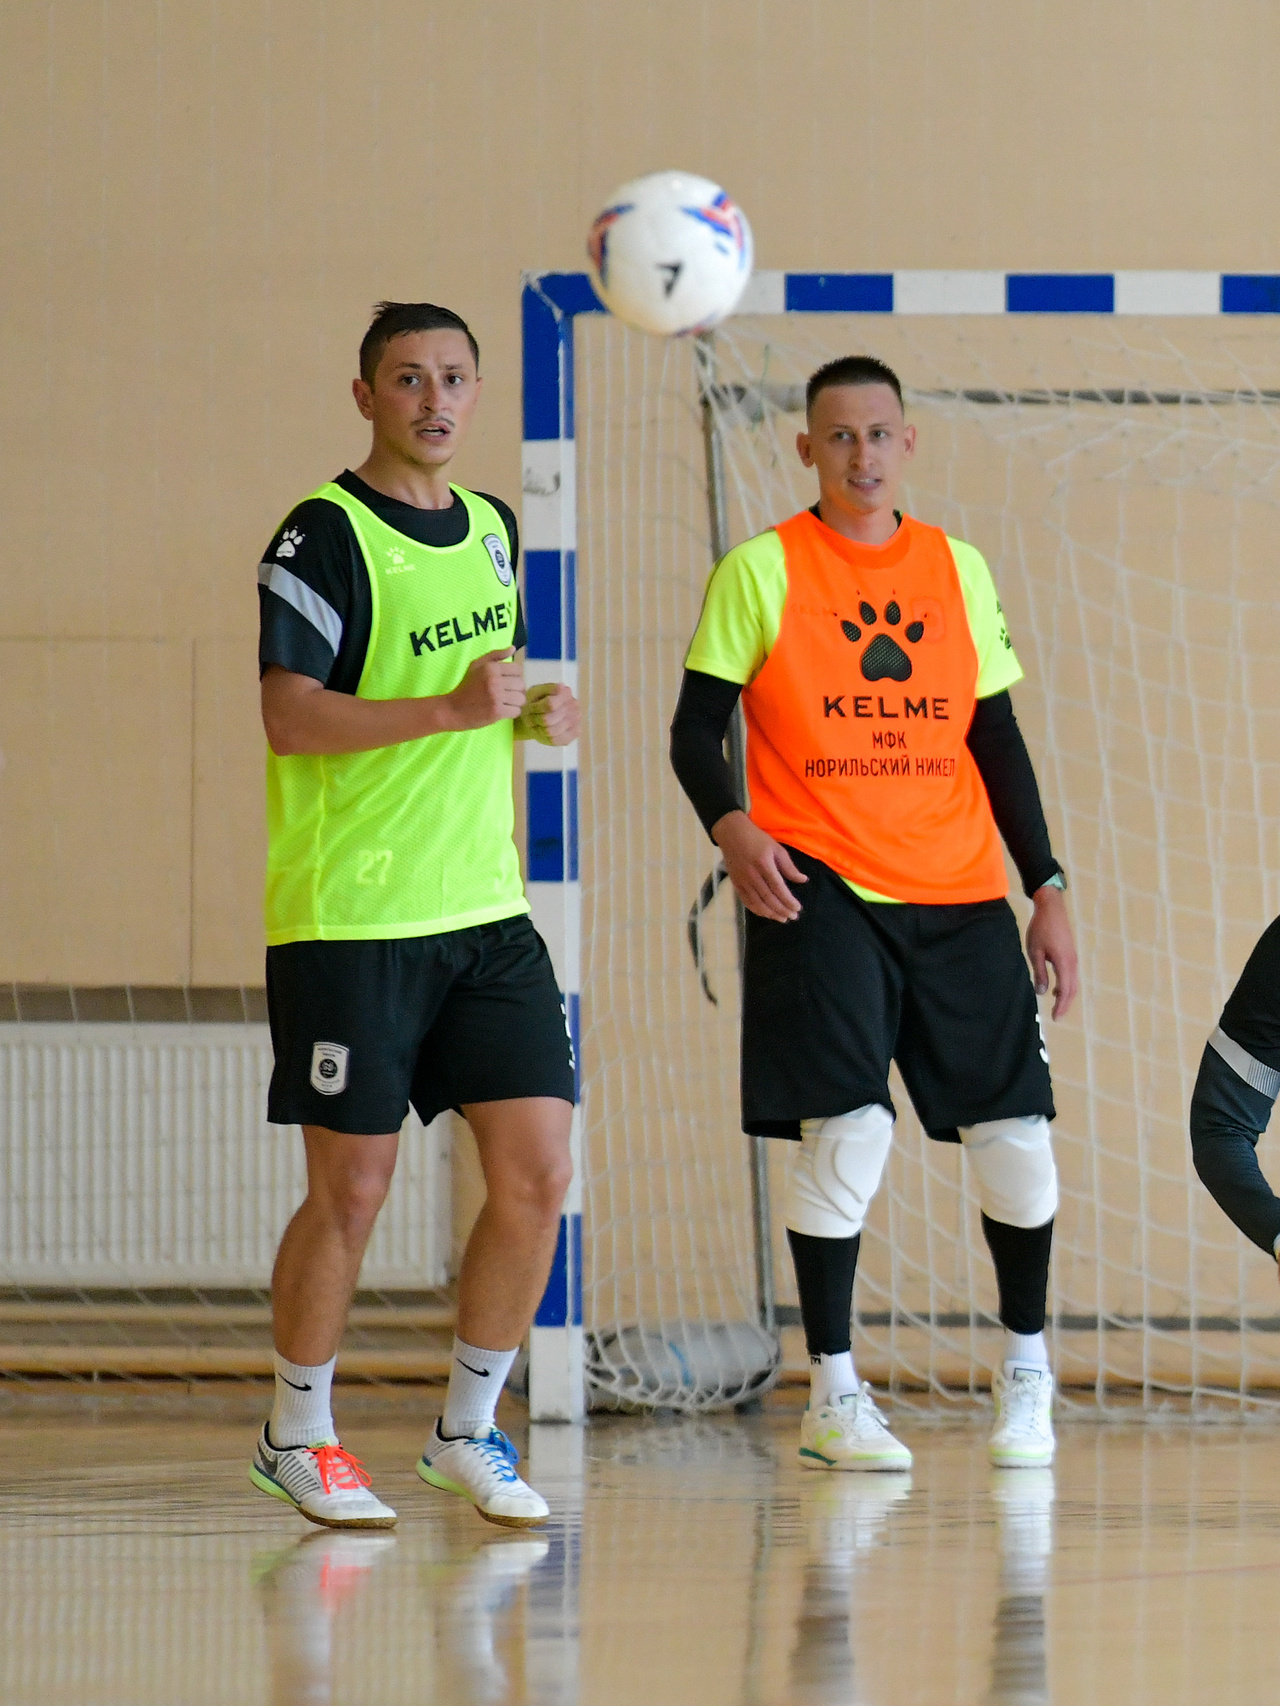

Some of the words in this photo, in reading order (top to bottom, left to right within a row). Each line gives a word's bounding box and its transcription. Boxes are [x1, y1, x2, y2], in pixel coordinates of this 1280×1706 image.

[409, 602, 508, 657] KELME
[823, 695, 950, 720] KELME
[872, 730, 907, 750] МФК
[804, 754, 910, 778] НОРИЛЬСКИЙ
[356, 849, 394, 886] 27
